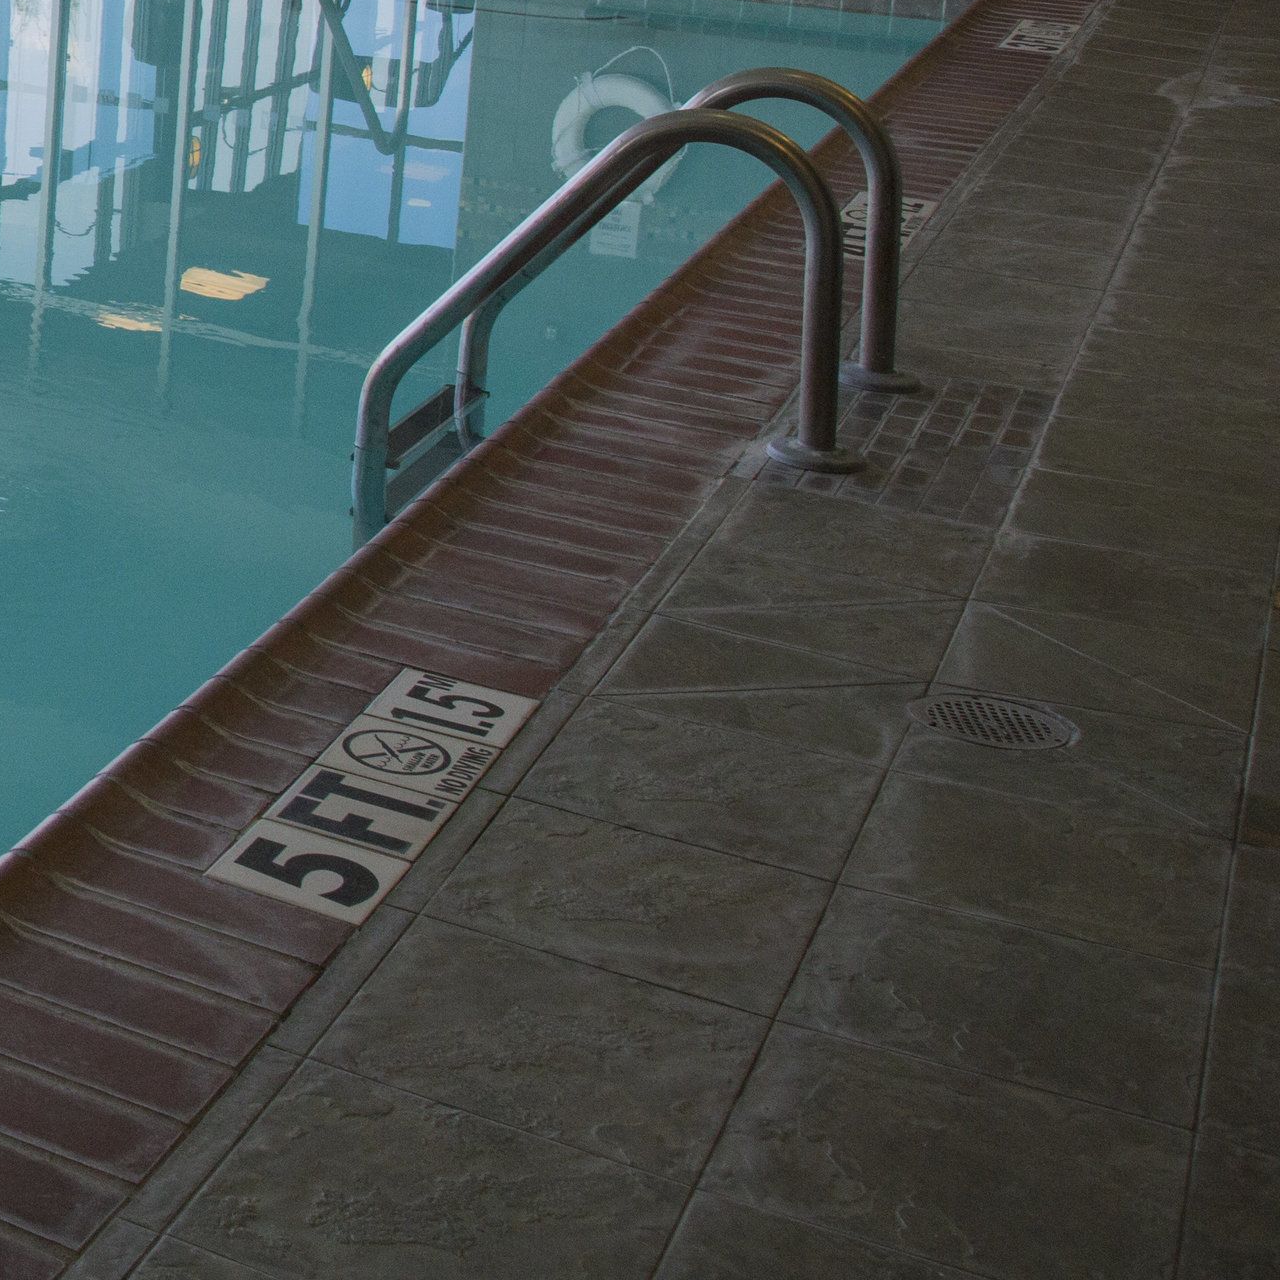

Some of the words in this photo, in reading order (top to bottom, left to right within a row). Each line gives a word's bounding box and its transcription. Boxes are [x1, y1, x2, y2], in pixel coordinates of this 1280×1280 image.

[446, 746, 493, 779] DIVING
[233, 836, 381, 909] 5
[390, 673, 505, 738] 1.5M
[434, 778, 468, 796] NO
